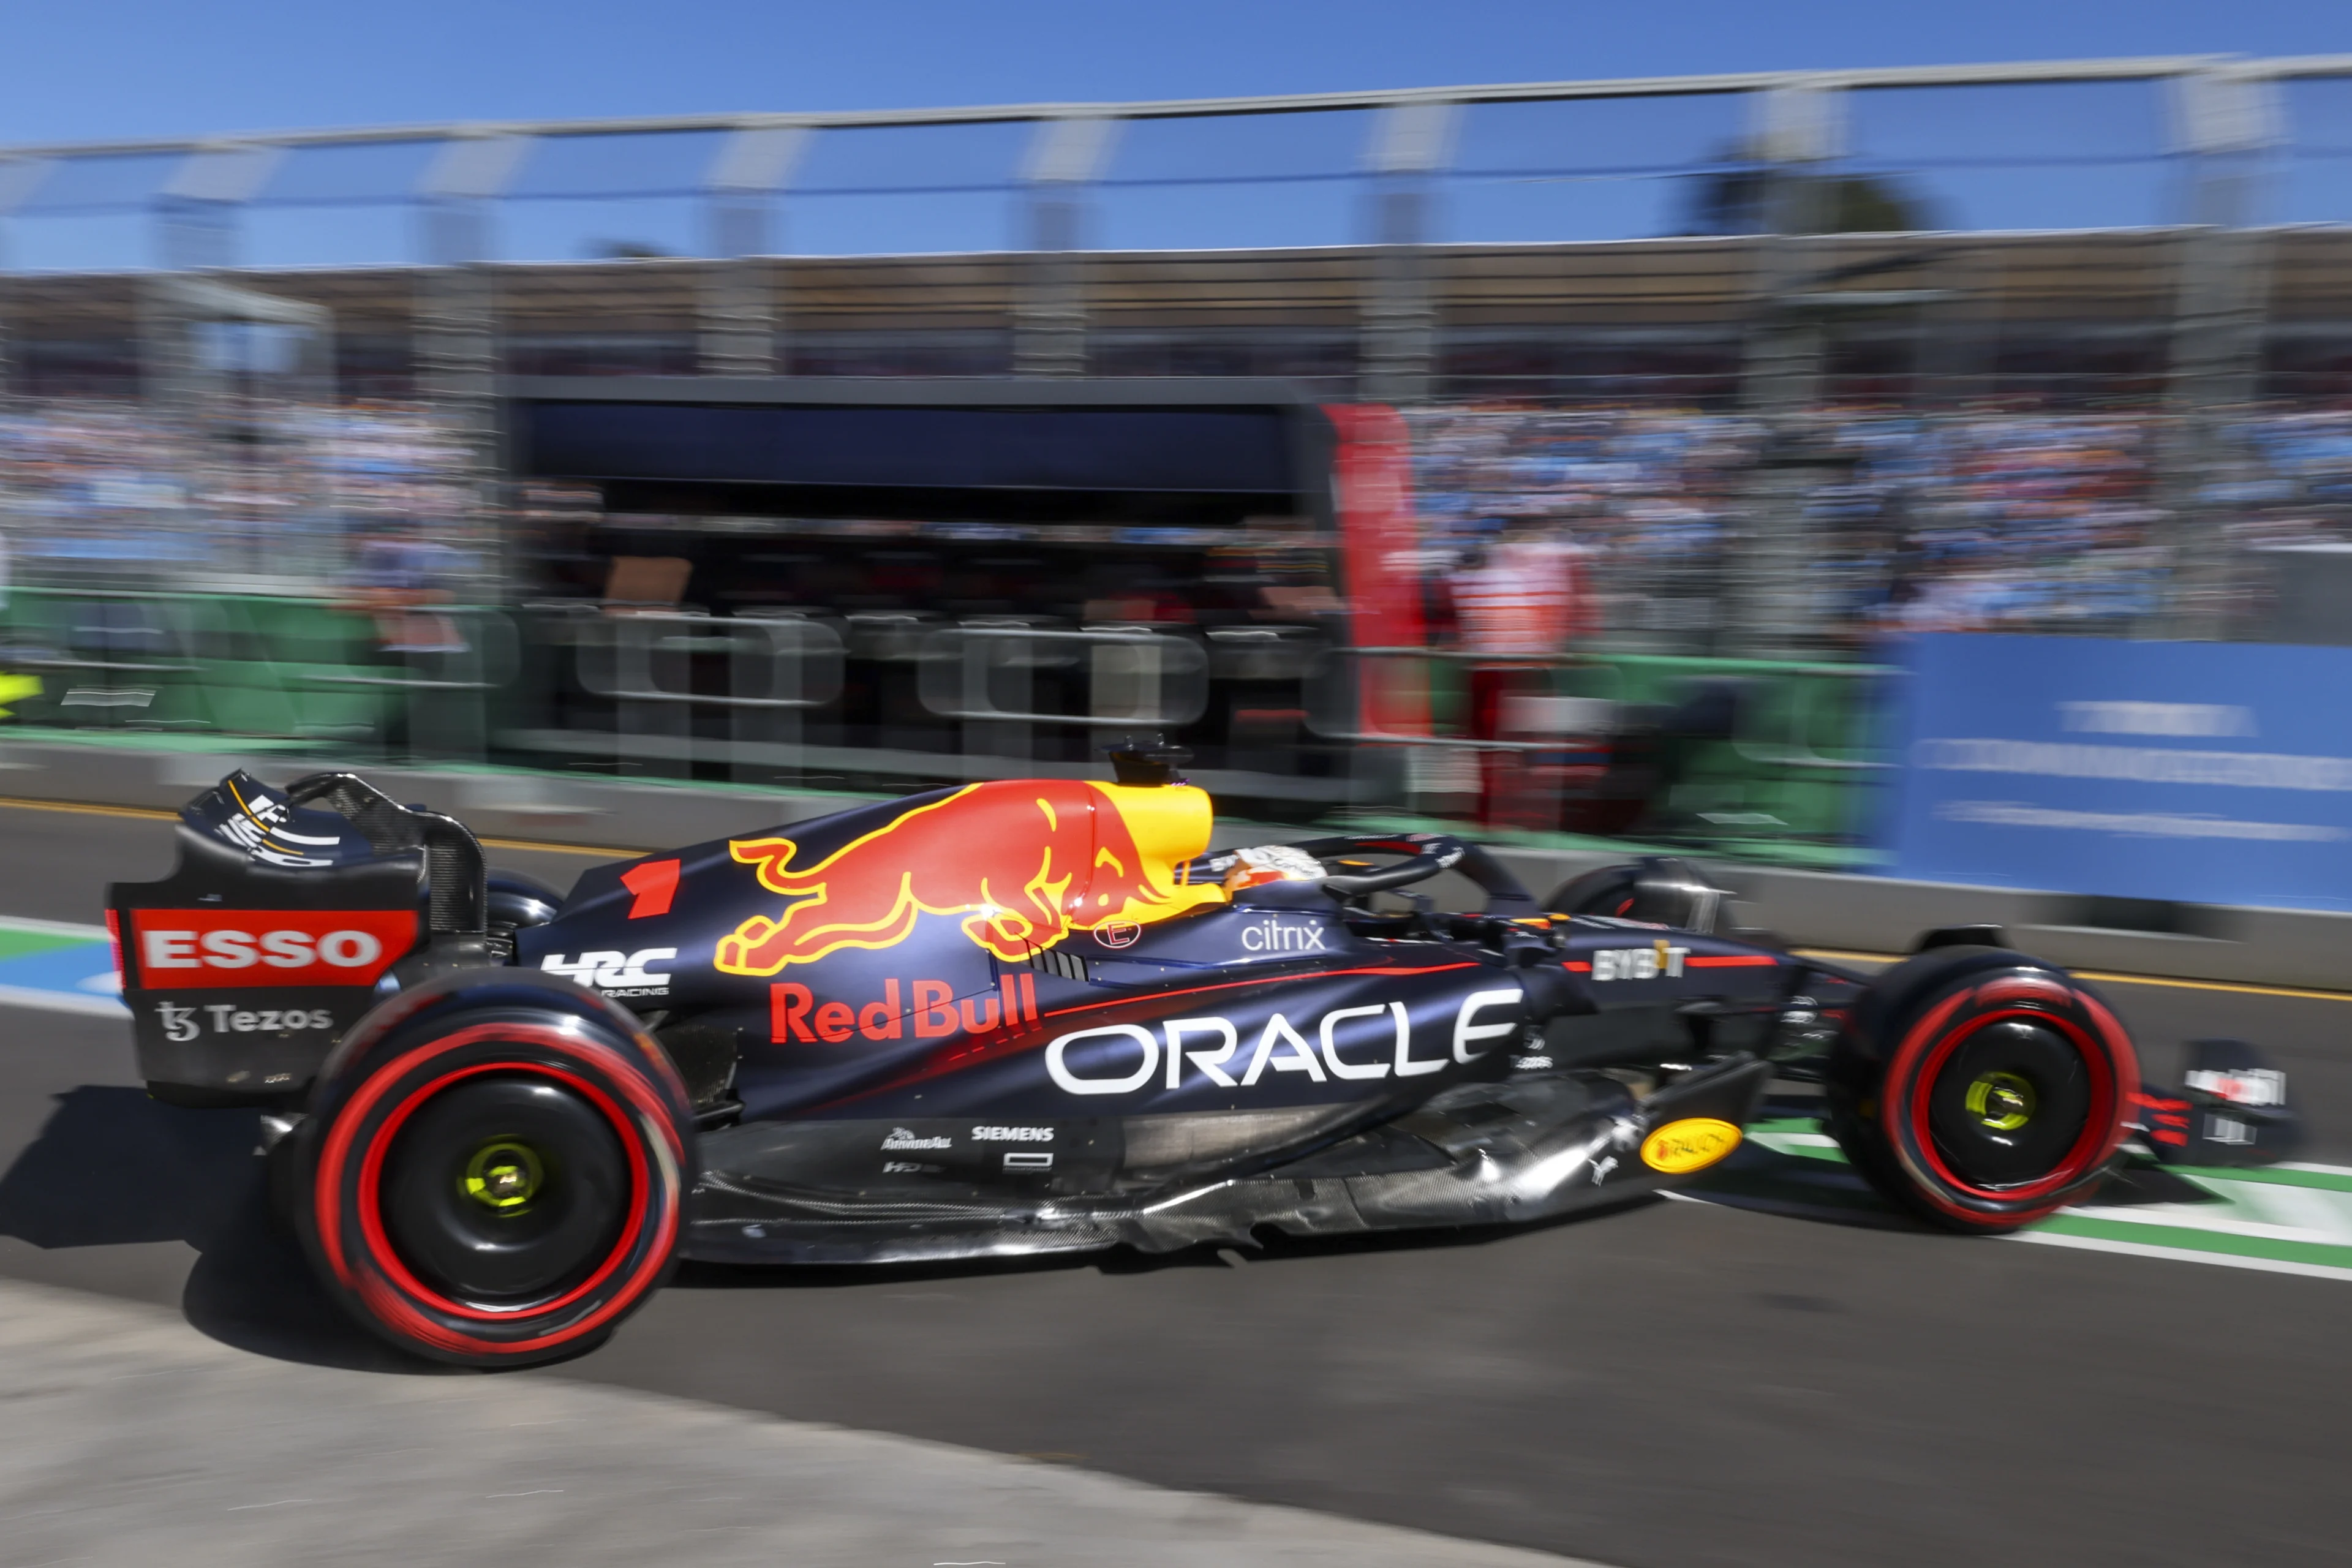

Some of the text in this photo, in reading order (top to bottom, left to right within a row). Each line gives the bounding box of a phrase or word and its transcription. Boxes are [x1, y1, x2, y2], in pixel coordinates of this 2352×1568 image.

[619, 859, 680, 919] 1
[141, 929, 383, 968] ESSO
[1242, 920, 1327, 951] citrix
[601, 987, 669, 997] RACING
[770, 973, 1038, 1043] Red Bull
[203, 1004, 334, 1033] Tezos
[1045, 988, 1524, 1095] ORACLE
[971, 1126, 1054, 1141] SIEMENS
